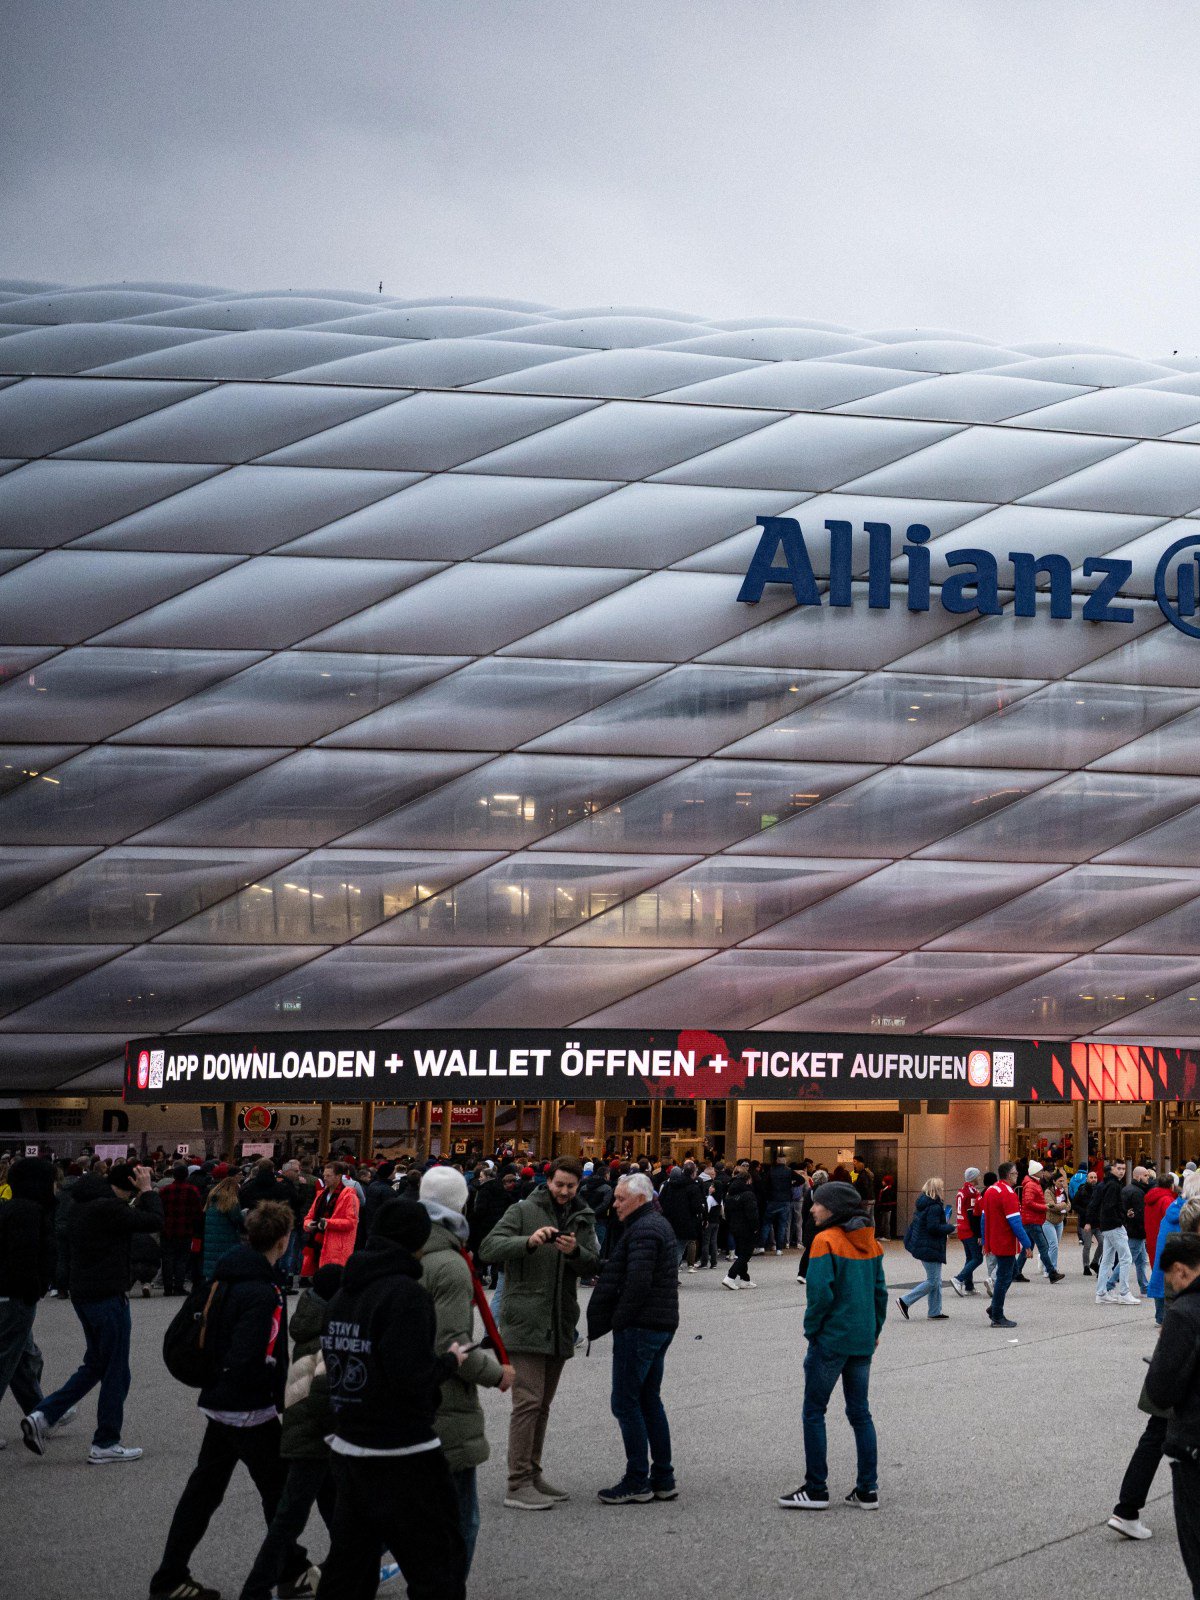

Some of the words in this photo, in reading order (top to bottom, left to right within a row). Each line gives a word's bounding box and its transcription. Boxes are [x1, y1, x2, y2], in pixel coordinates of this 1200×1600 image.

[736, 514, 1134, 624] Allianz
[165, 1054, 199, 1082] APP
[203, 1050, 376, 1081] DOWNLOADEN
[413, 1049, 551, 1076] WALLET
[560, 1041, 695, 1077] ÖFFNEN
[741, 1051, 843, 1078] TICKET
[850, 1053, 967, 1080] AUFRUFEN
[27, 1147, 37, 1155] 32
[328, 1321, 352, 1337] STAY
